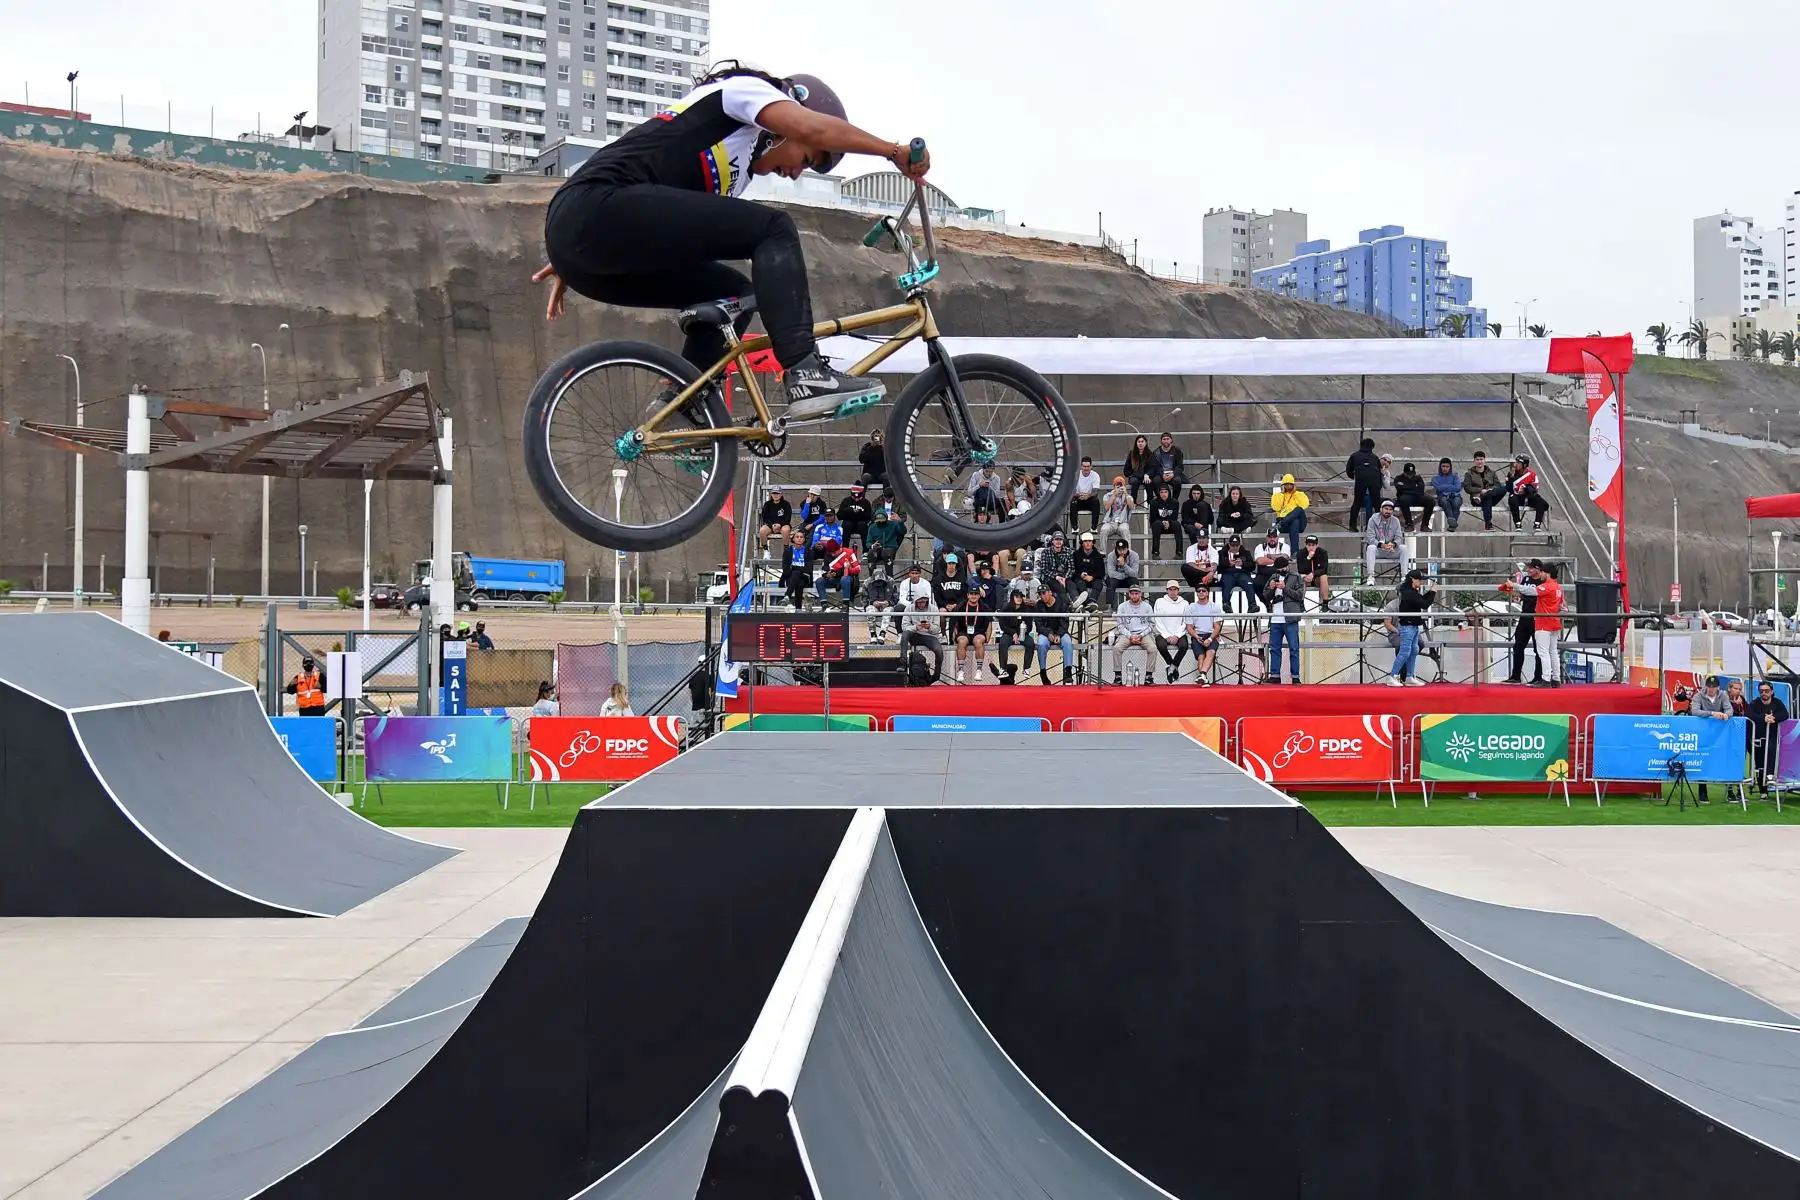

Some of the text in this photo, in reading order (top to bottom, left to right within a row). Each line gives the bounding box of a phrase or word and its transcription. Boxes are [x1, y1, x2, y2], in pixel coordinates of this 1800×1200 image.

[726, 155, 740, 198] VENE
[940, 581, 962, 590] VANS
[759, 624, 846, 661] 0:56
[1678, 732, 1698, 741] san
[605, 739, 649, 752] FDPC
[1319, 739, 1363, 752] FDPC
[1659, 739, 1698, 753] miguel
[1478, 751, 1514, 760] Seguimos
